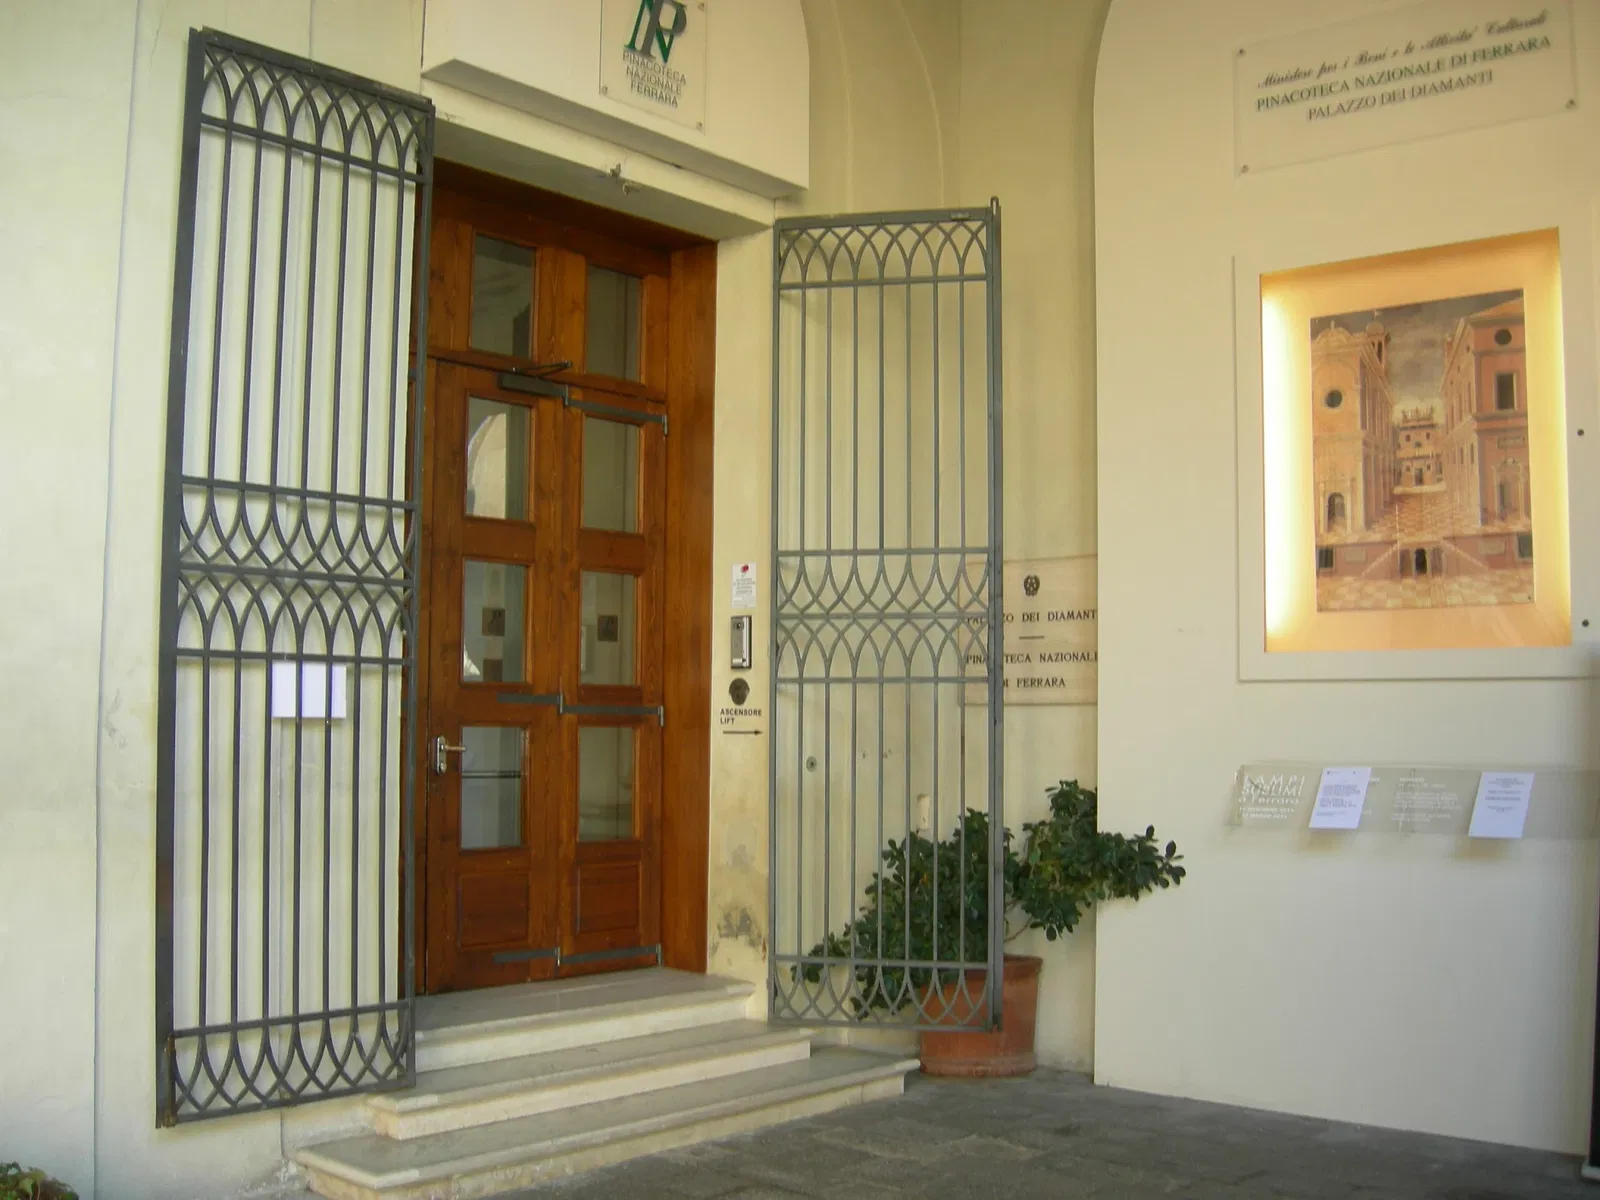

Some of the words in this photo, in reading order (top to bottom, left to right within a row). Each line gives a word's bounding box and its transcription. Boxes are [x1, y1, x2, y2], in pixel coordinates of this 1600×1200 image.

[622, 49, 687, 86] PINACOTECA
[1355, 47, 1388, 66] Beni
[626, 65, 682, 96] NAZIONALE
[1256, 80, 1350, 111] PINACOTECA
[1354, 57, 1445, 89] NAZIONALE
[1451, 51, 1468, 69] DI
[1473, 36, 1551, 64] FERRARA
[630, 80, 679, 109] FERRARA
[1308, 95, 1377, 121] PALAZZO
[1381, 88, 1406, 107] DEI
[1411, 69, 1493, 99] DIAMANTI
[1021, 612, 1040, 623] DEI
[1016, 677, 1066, 689] FERRARA
[720, 708, 763, 717] ASCENSORE
[720, 717, 736, 725] LIFT
